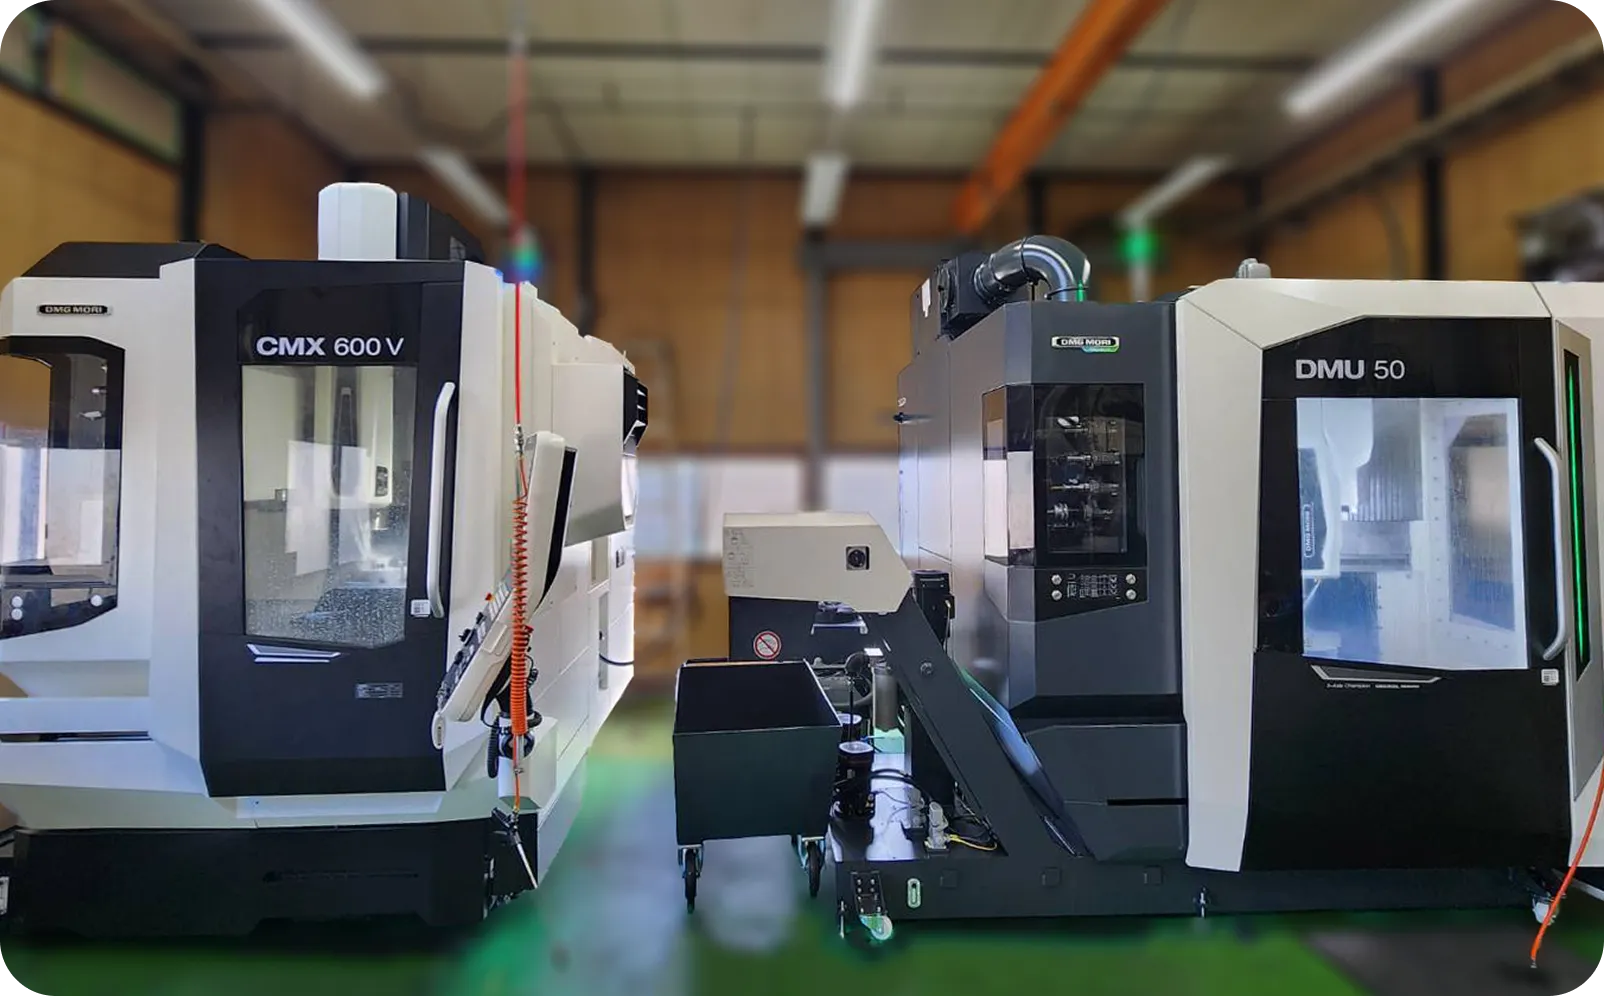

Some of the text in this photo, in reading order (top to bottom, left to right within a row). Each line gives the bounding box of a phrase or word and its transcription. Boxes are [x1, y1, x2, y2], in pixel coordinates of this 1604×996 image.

[45, 306, 103, 314] DMG MORI
[256, 336, 405, 356] CMX 600 V
[1061, 338, 1111, 346] DMG MORI
[1295, 359, 1406, 380] DMU 50
